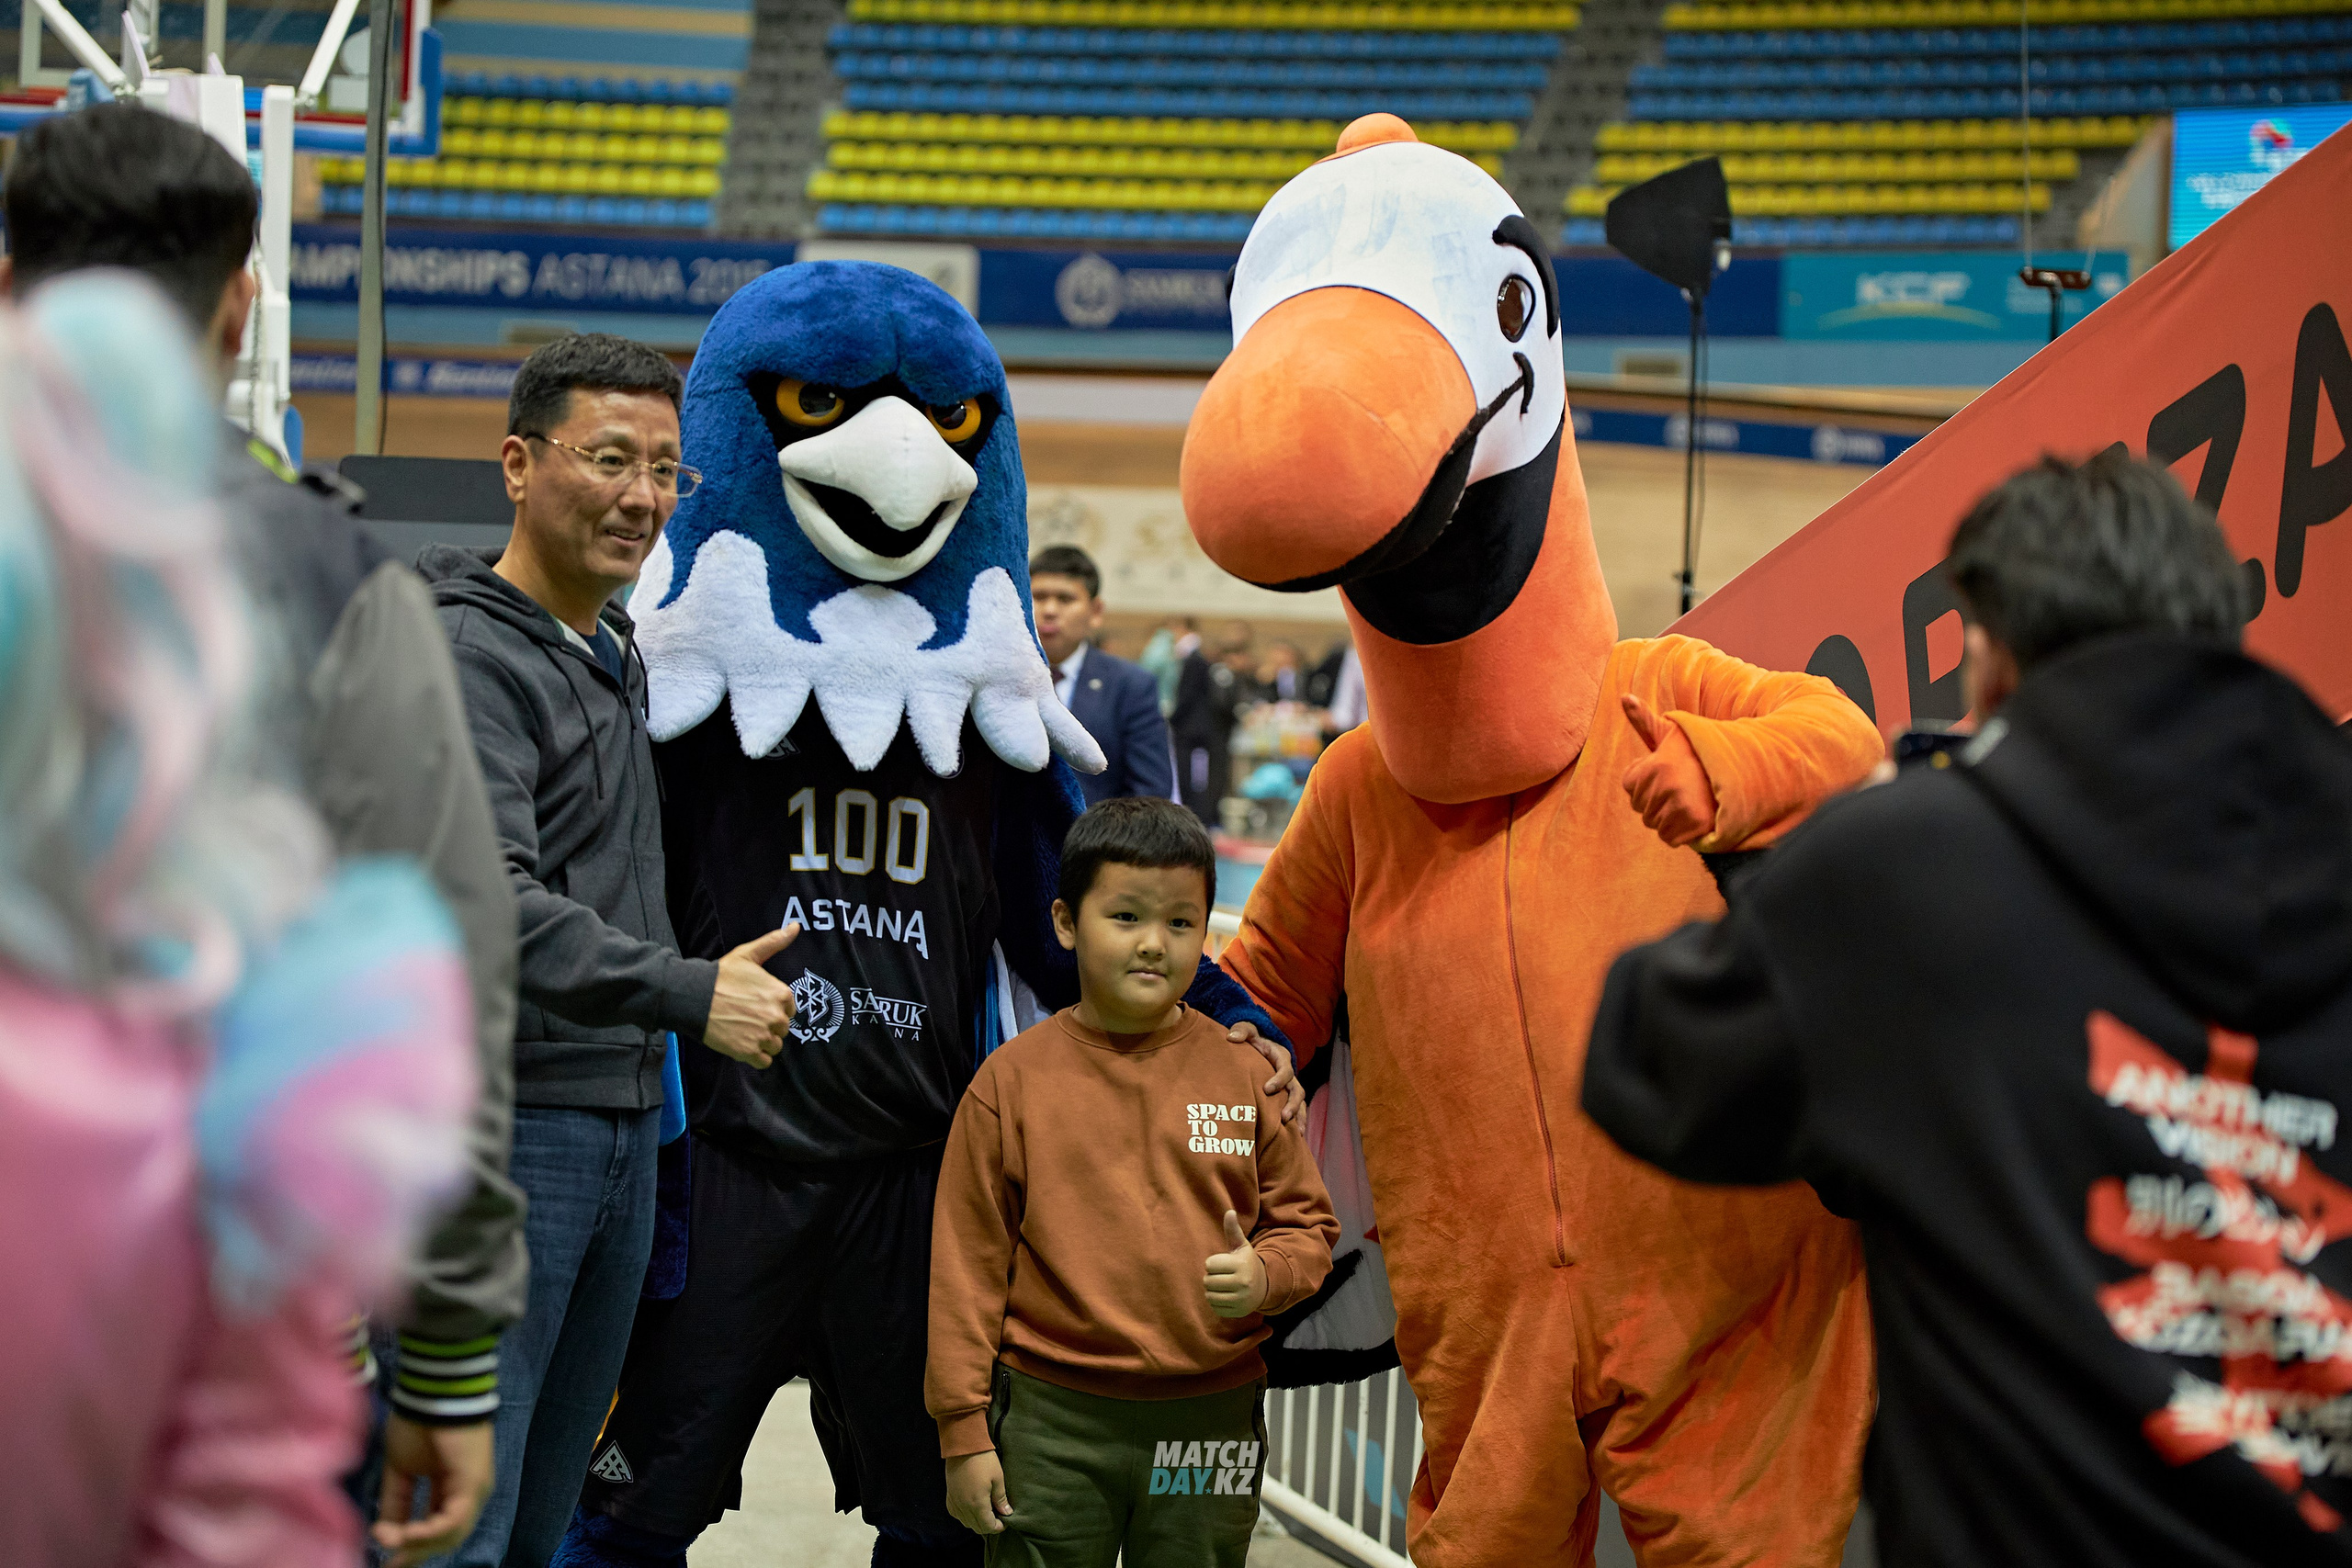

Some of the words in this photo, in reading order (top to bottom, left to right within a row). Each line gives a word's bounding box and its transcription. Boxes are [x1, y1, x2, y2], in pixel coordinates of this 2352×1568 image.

[532, 251, 685, 302] ASTANA
[787, 786, 930, 885] 100
[781, 896, 929, 960] ASTANA
[1186, 1103, 1257, 1122] SPACE
[1187, 1120, 1218, 1136] TO
[2106, 1062, 2339, 1150] ANOTHER
[1188, 1136, 1255, 1156] GROW
[2146, 1111, 2301, 1187] VISION
